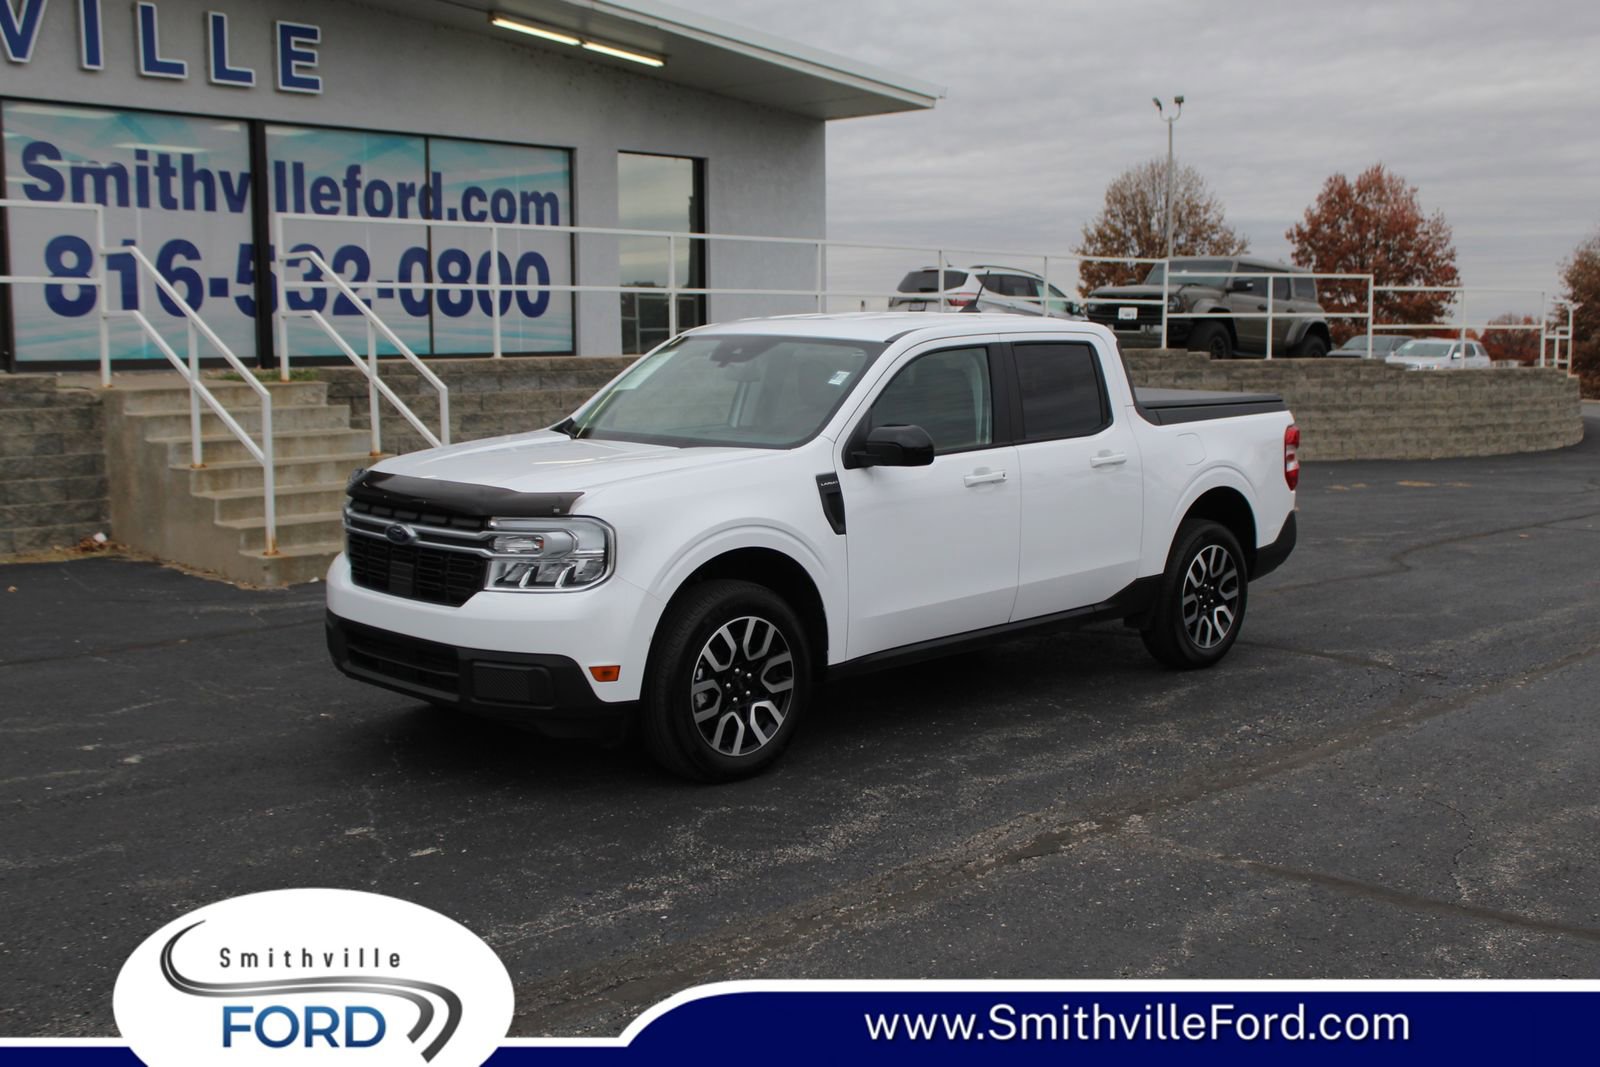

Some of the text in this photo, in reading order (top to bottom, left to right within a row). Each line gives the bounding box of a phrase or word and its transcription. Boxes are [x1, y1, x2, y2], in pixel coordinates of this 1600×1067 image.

[0, 0, 322, 94] VILLE
[21, 140, 560, 226] Smithvlleford.com
[44, 234, 550, 318] 816-532-0800
